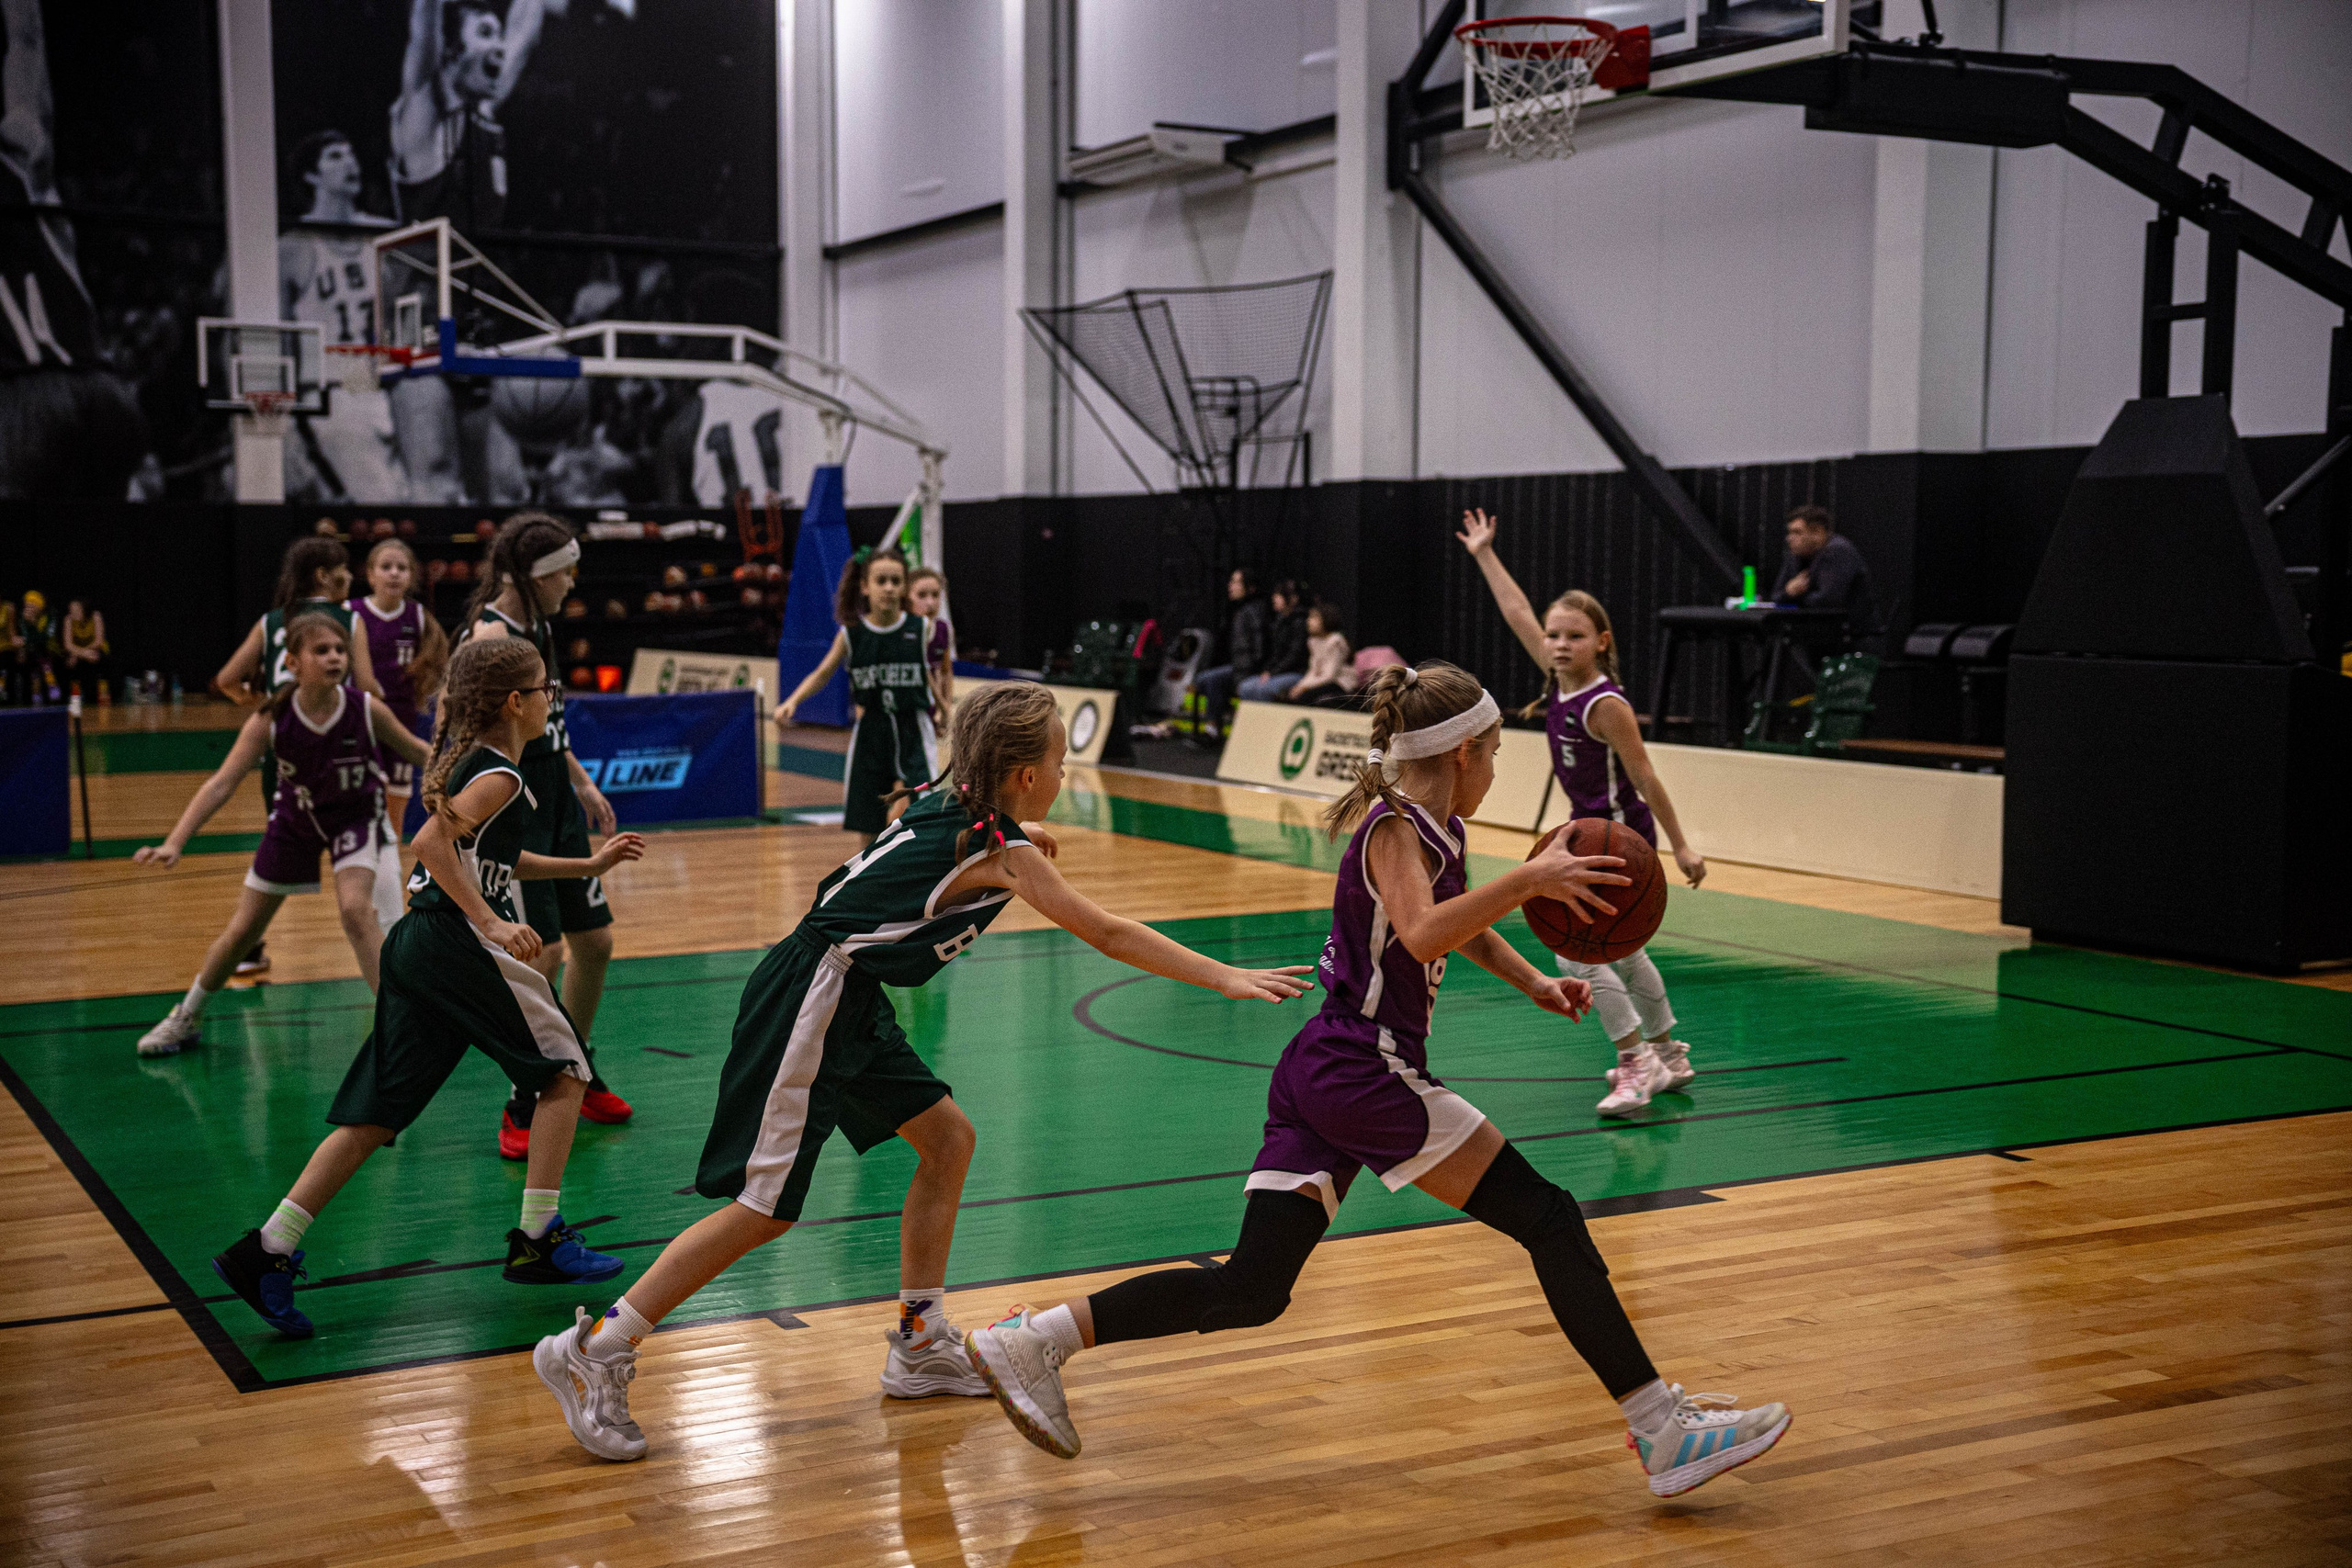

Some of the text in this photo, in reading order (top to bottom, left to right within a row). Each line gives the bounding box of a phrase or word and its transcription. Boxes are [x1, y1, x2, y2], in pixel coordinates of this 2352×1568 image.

[1561, 742, 1577, 769] 5
[336, 764, 366, 791] 13
[610, 760, 682, 786] LINE
[332, 829, 357, 856] 13
